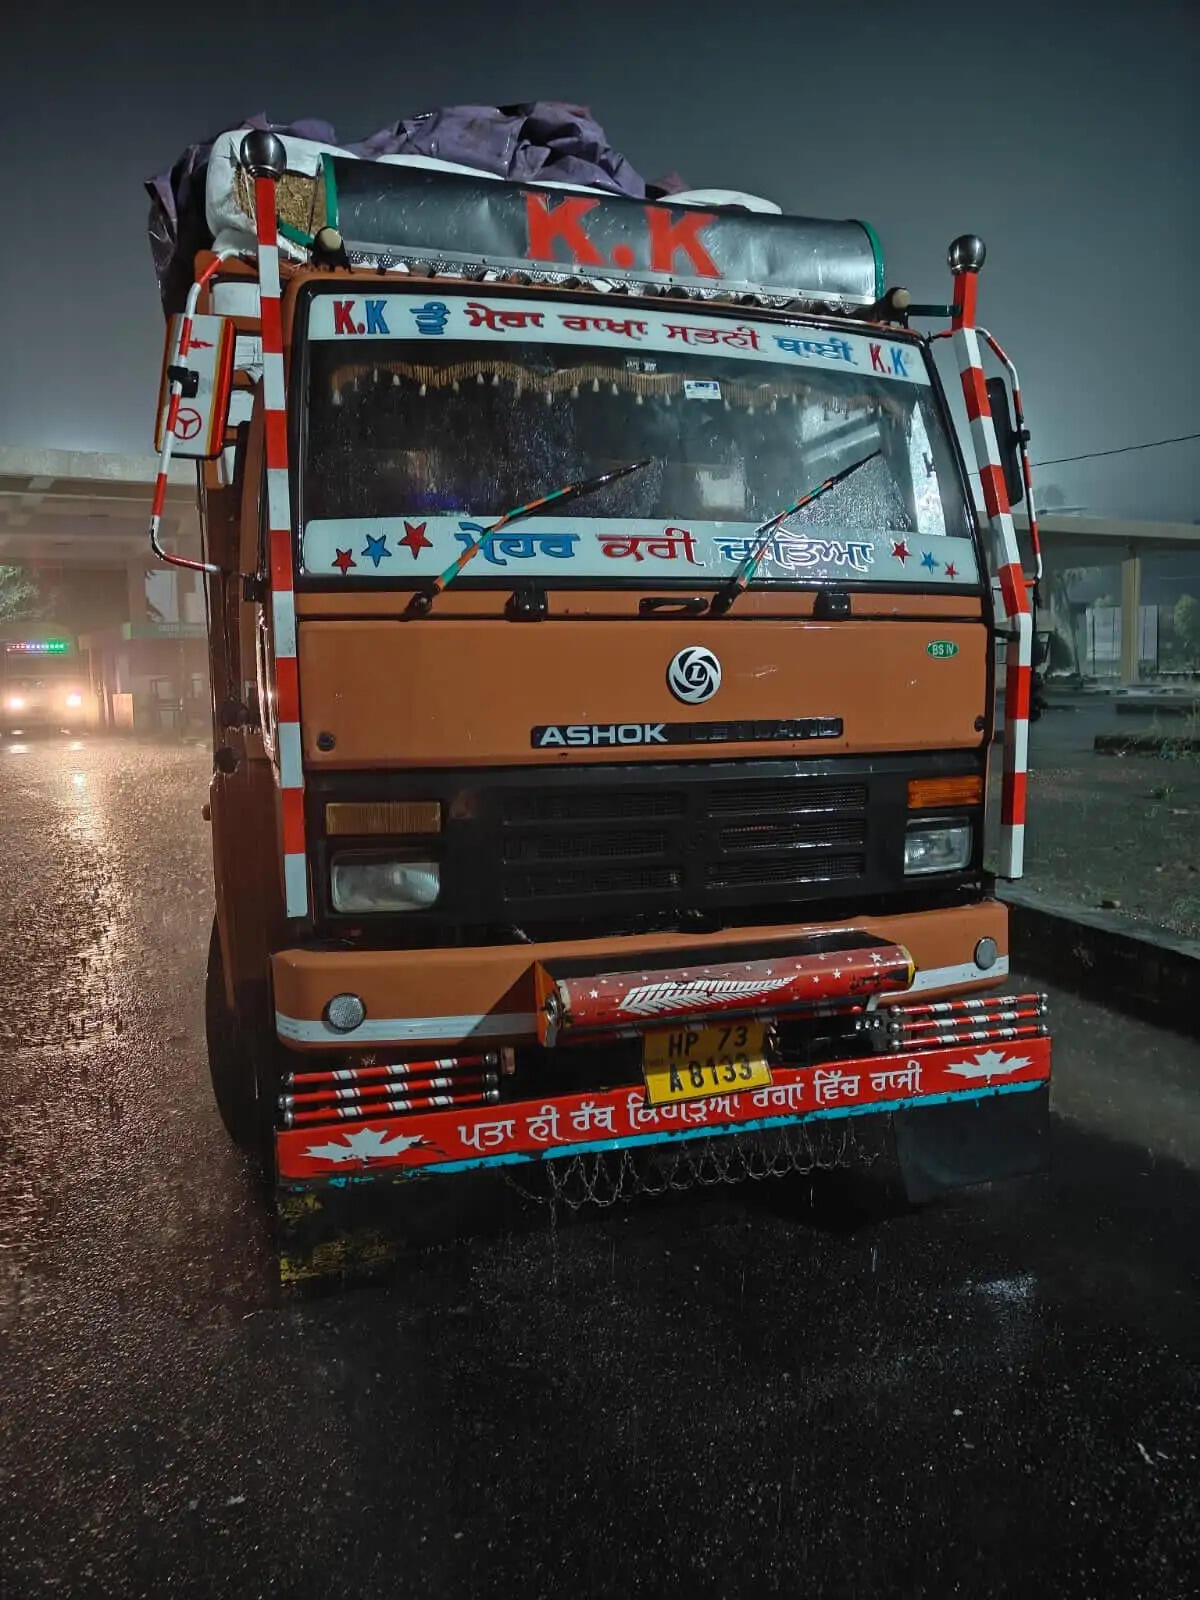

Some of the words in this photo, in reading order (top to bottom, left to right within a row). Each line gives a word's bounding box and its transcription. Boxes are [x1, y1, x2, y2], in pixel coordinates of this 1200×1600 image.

[525, 191, 724, 280] K.K
[333, 299, 390, 335] K.K
[463, 301, 545, 333] ਮੇਰਾ
[557, 314, 648, 341] ਰਾਖਾ
[869, 342, 908, 377] K.K
[596, 527, 706, 567] ਕਰੀ
[932, 644, 944, 656] BS
[946, 644, 955, 655] IV
[540, 724, 668, 746] ASHOK
[668, 1032, 699, 1058] HP
[717, 1025, 749, 1052] 73
[458, 1119, 516, 1151] ਪਤਾ
[526, 1105, 566, 1141] ਨੀ
[570, 1101, 618, 1134] ਰੱਬ
[813, 1069, 861, 1105] ਵਿੱਚ
